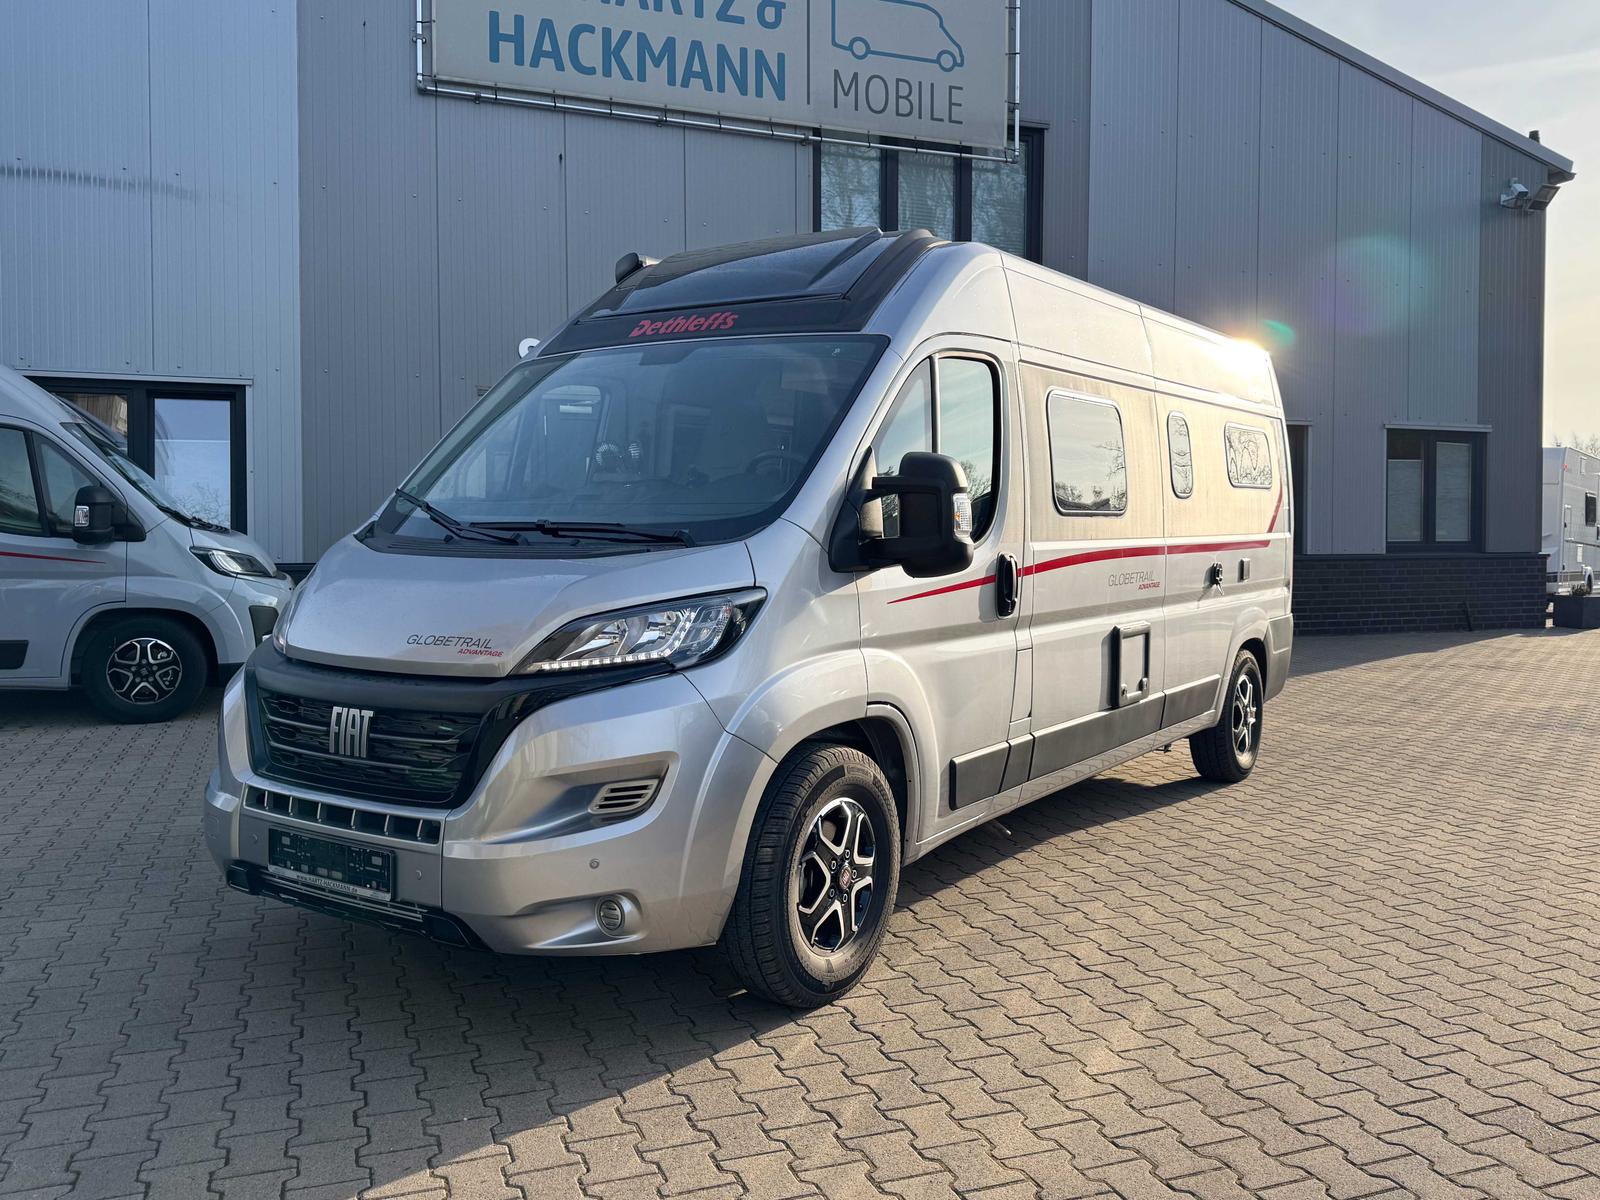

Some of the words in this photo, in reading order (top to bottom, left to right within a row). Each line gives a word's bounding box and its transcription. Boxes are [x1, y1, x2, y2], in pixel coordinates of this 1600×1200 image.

[487, 11, 786, 101] HACKMANN
[832, 69, 965, 125] MOBILE
[629, 311, 738, 338] Dethleffs
[1108, 570, 1155, 587] GLOBETRAIL
[406, 634, 493, 650] GLOBETRAIL
[457, 648, 504, 657] ADVANTAGE
[328, 706, 375, 758] FIAT
